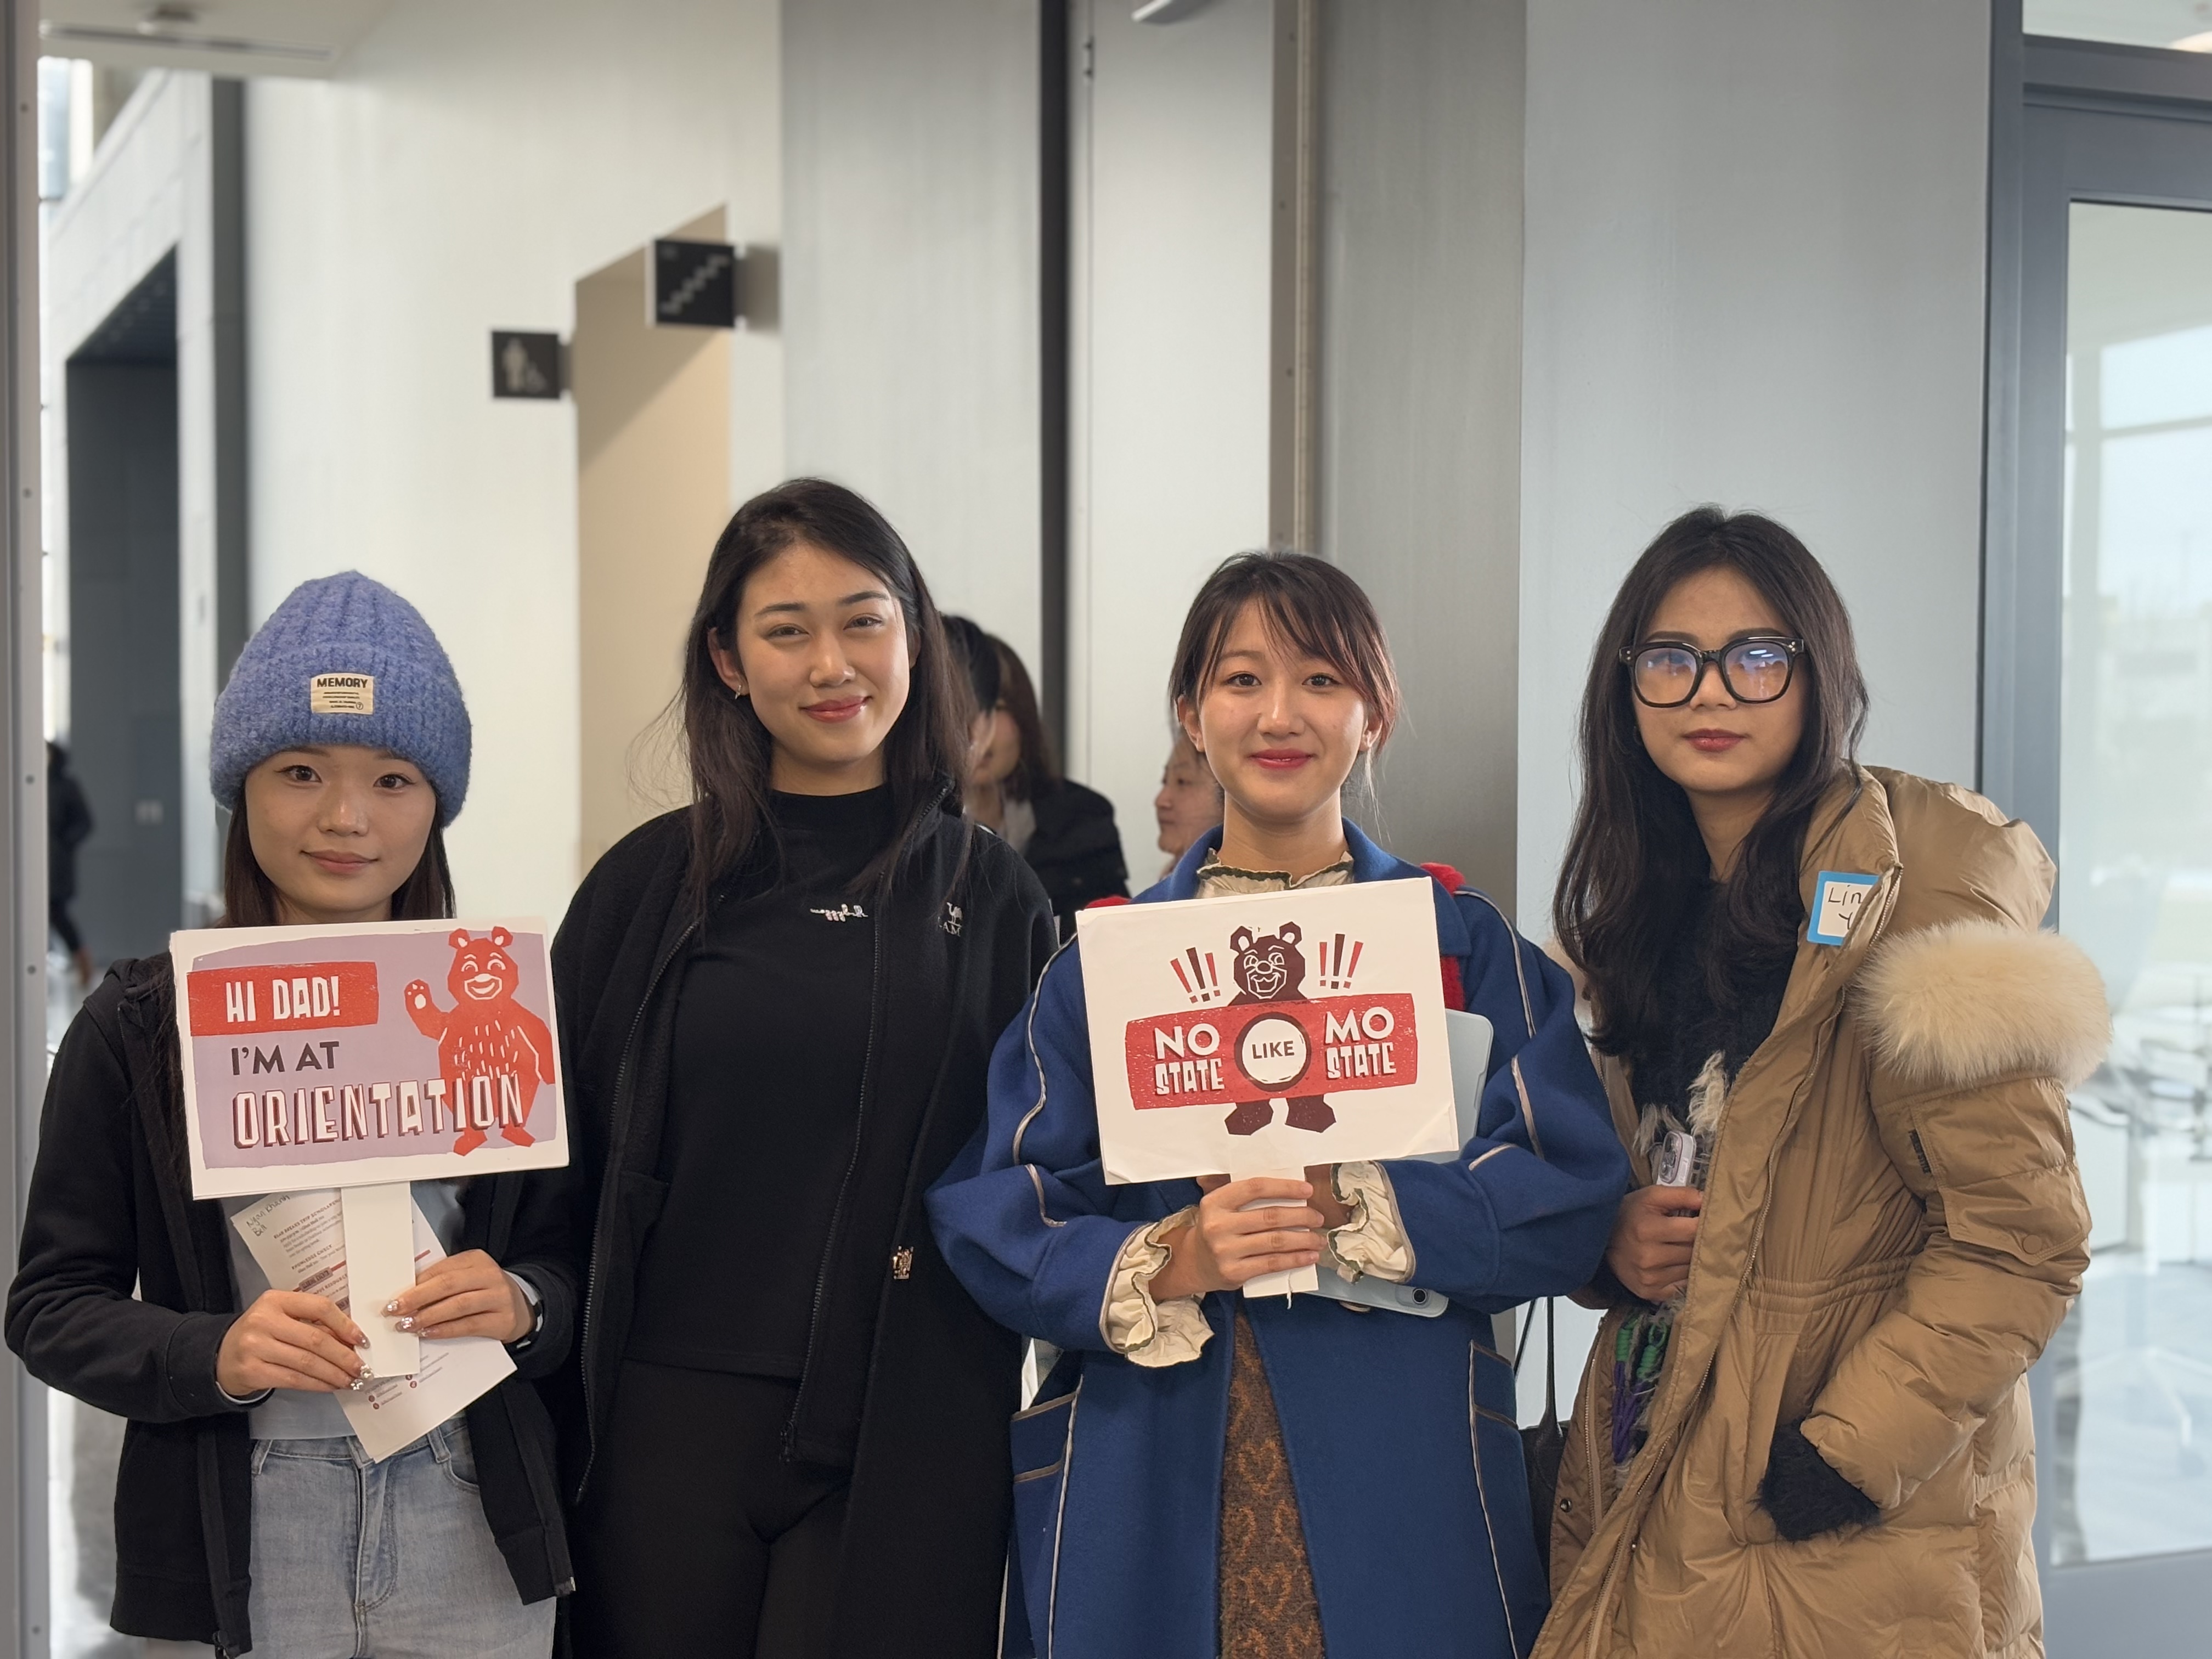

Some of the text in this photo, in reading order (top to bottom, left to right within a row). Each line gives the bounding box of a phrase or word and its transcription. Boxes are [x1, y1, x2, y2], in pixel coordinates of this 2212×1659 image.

[317, 678, 368, 688] MEMORY
[226, 976, 340, 1023] HI DAD!
[1154, 1023, 1221, 1060] NO
[1325, 1006, 1395, 1043] MO
[296, 1041, 339, 1071] AT
[1252, 1040, 1295, 1059] LIKE
[1326, 1042, 1396, 1079] STATE
[1155, 1058, 1224, 1095] STATE
[233, 1074, 524, 1149] ORIENTATION
